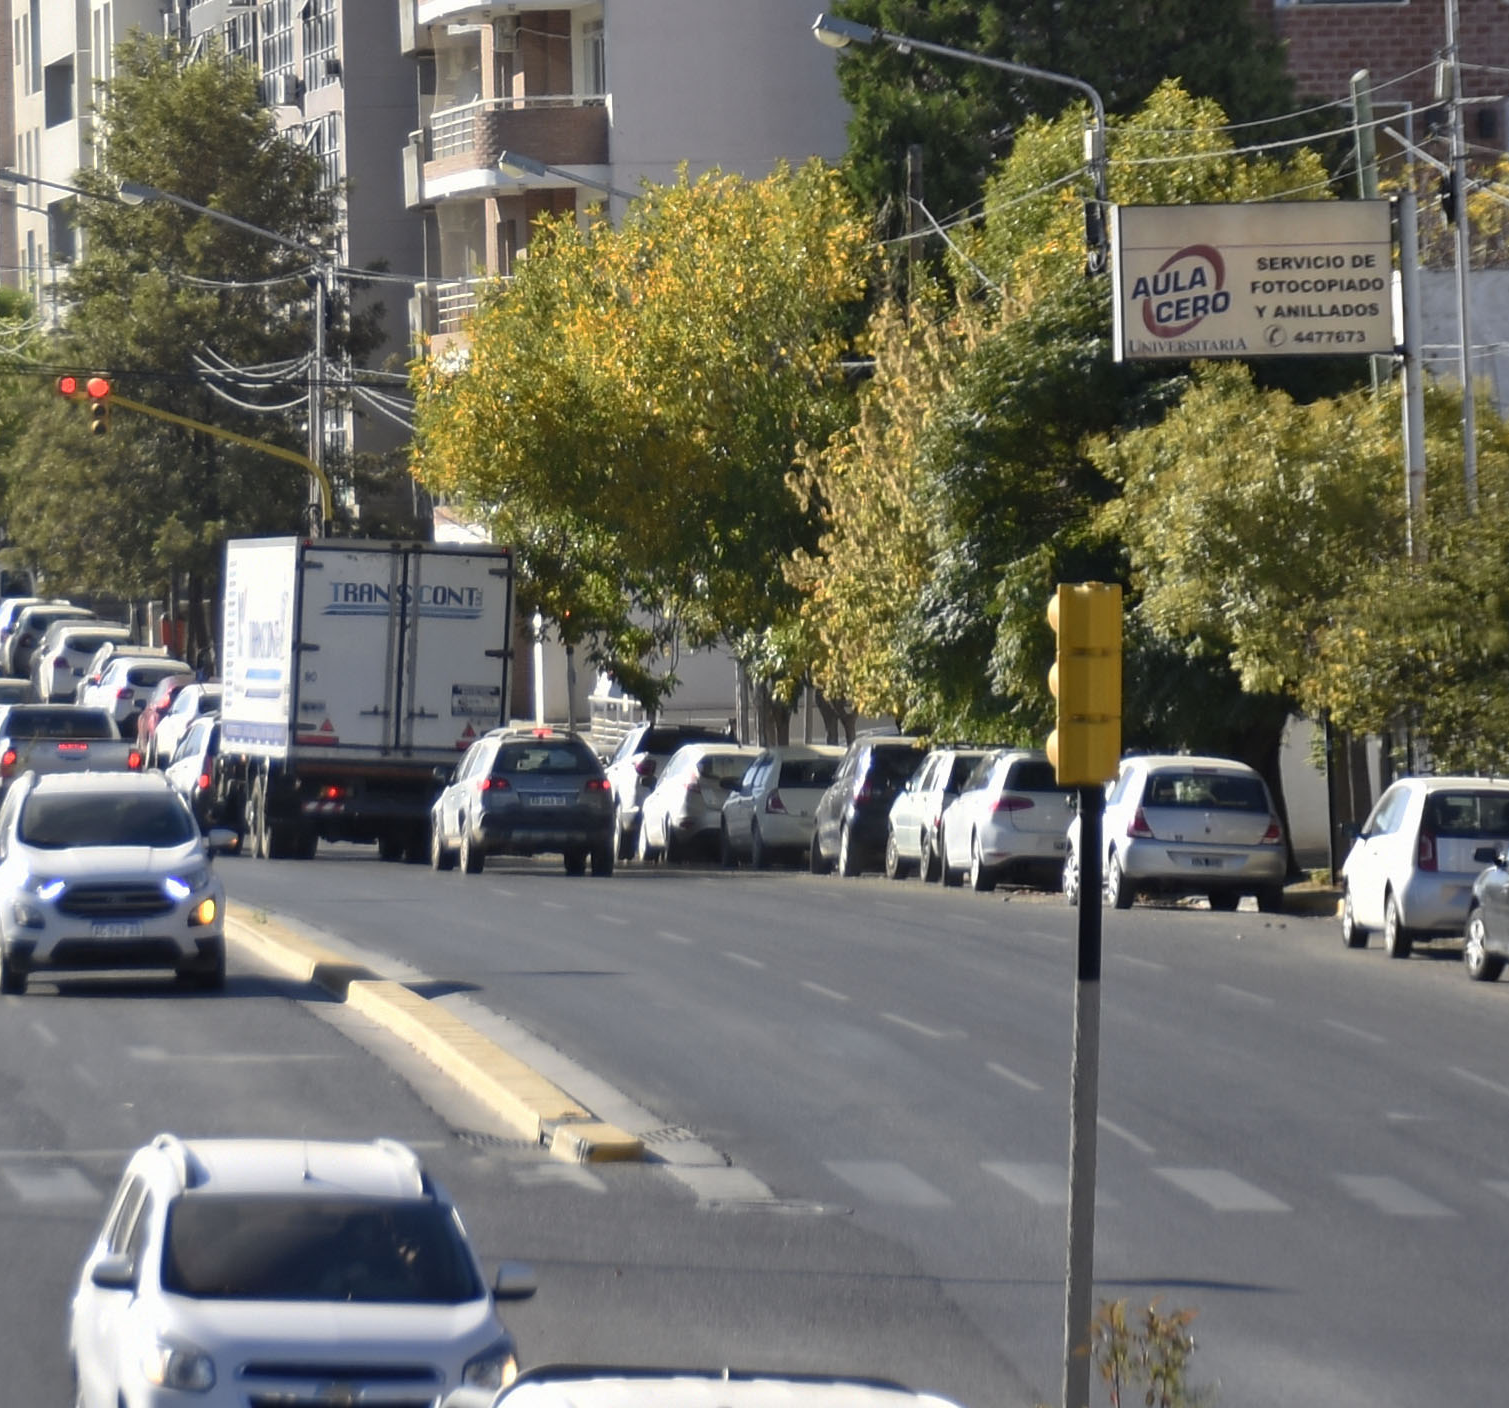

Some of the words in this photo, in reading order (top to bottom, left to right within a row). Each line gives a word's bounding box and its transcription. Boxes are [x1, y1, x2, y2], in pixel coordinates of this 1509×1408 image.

[1257, 255, 1345, 271] SERVICIO
[1352, 254, 1376, 268] DE
[1131, 266, 1208, 300] AULA
[1251, 277, 1384, 294] FOTOCOPIADO
[1156, 291, 1230, 324] CERO
[1255, 304, 1267, 318] Y
[1273, 302, 1379, 318] ANILLADOS
[1128, 338, 1248, 353] UNIVERSITARIA
